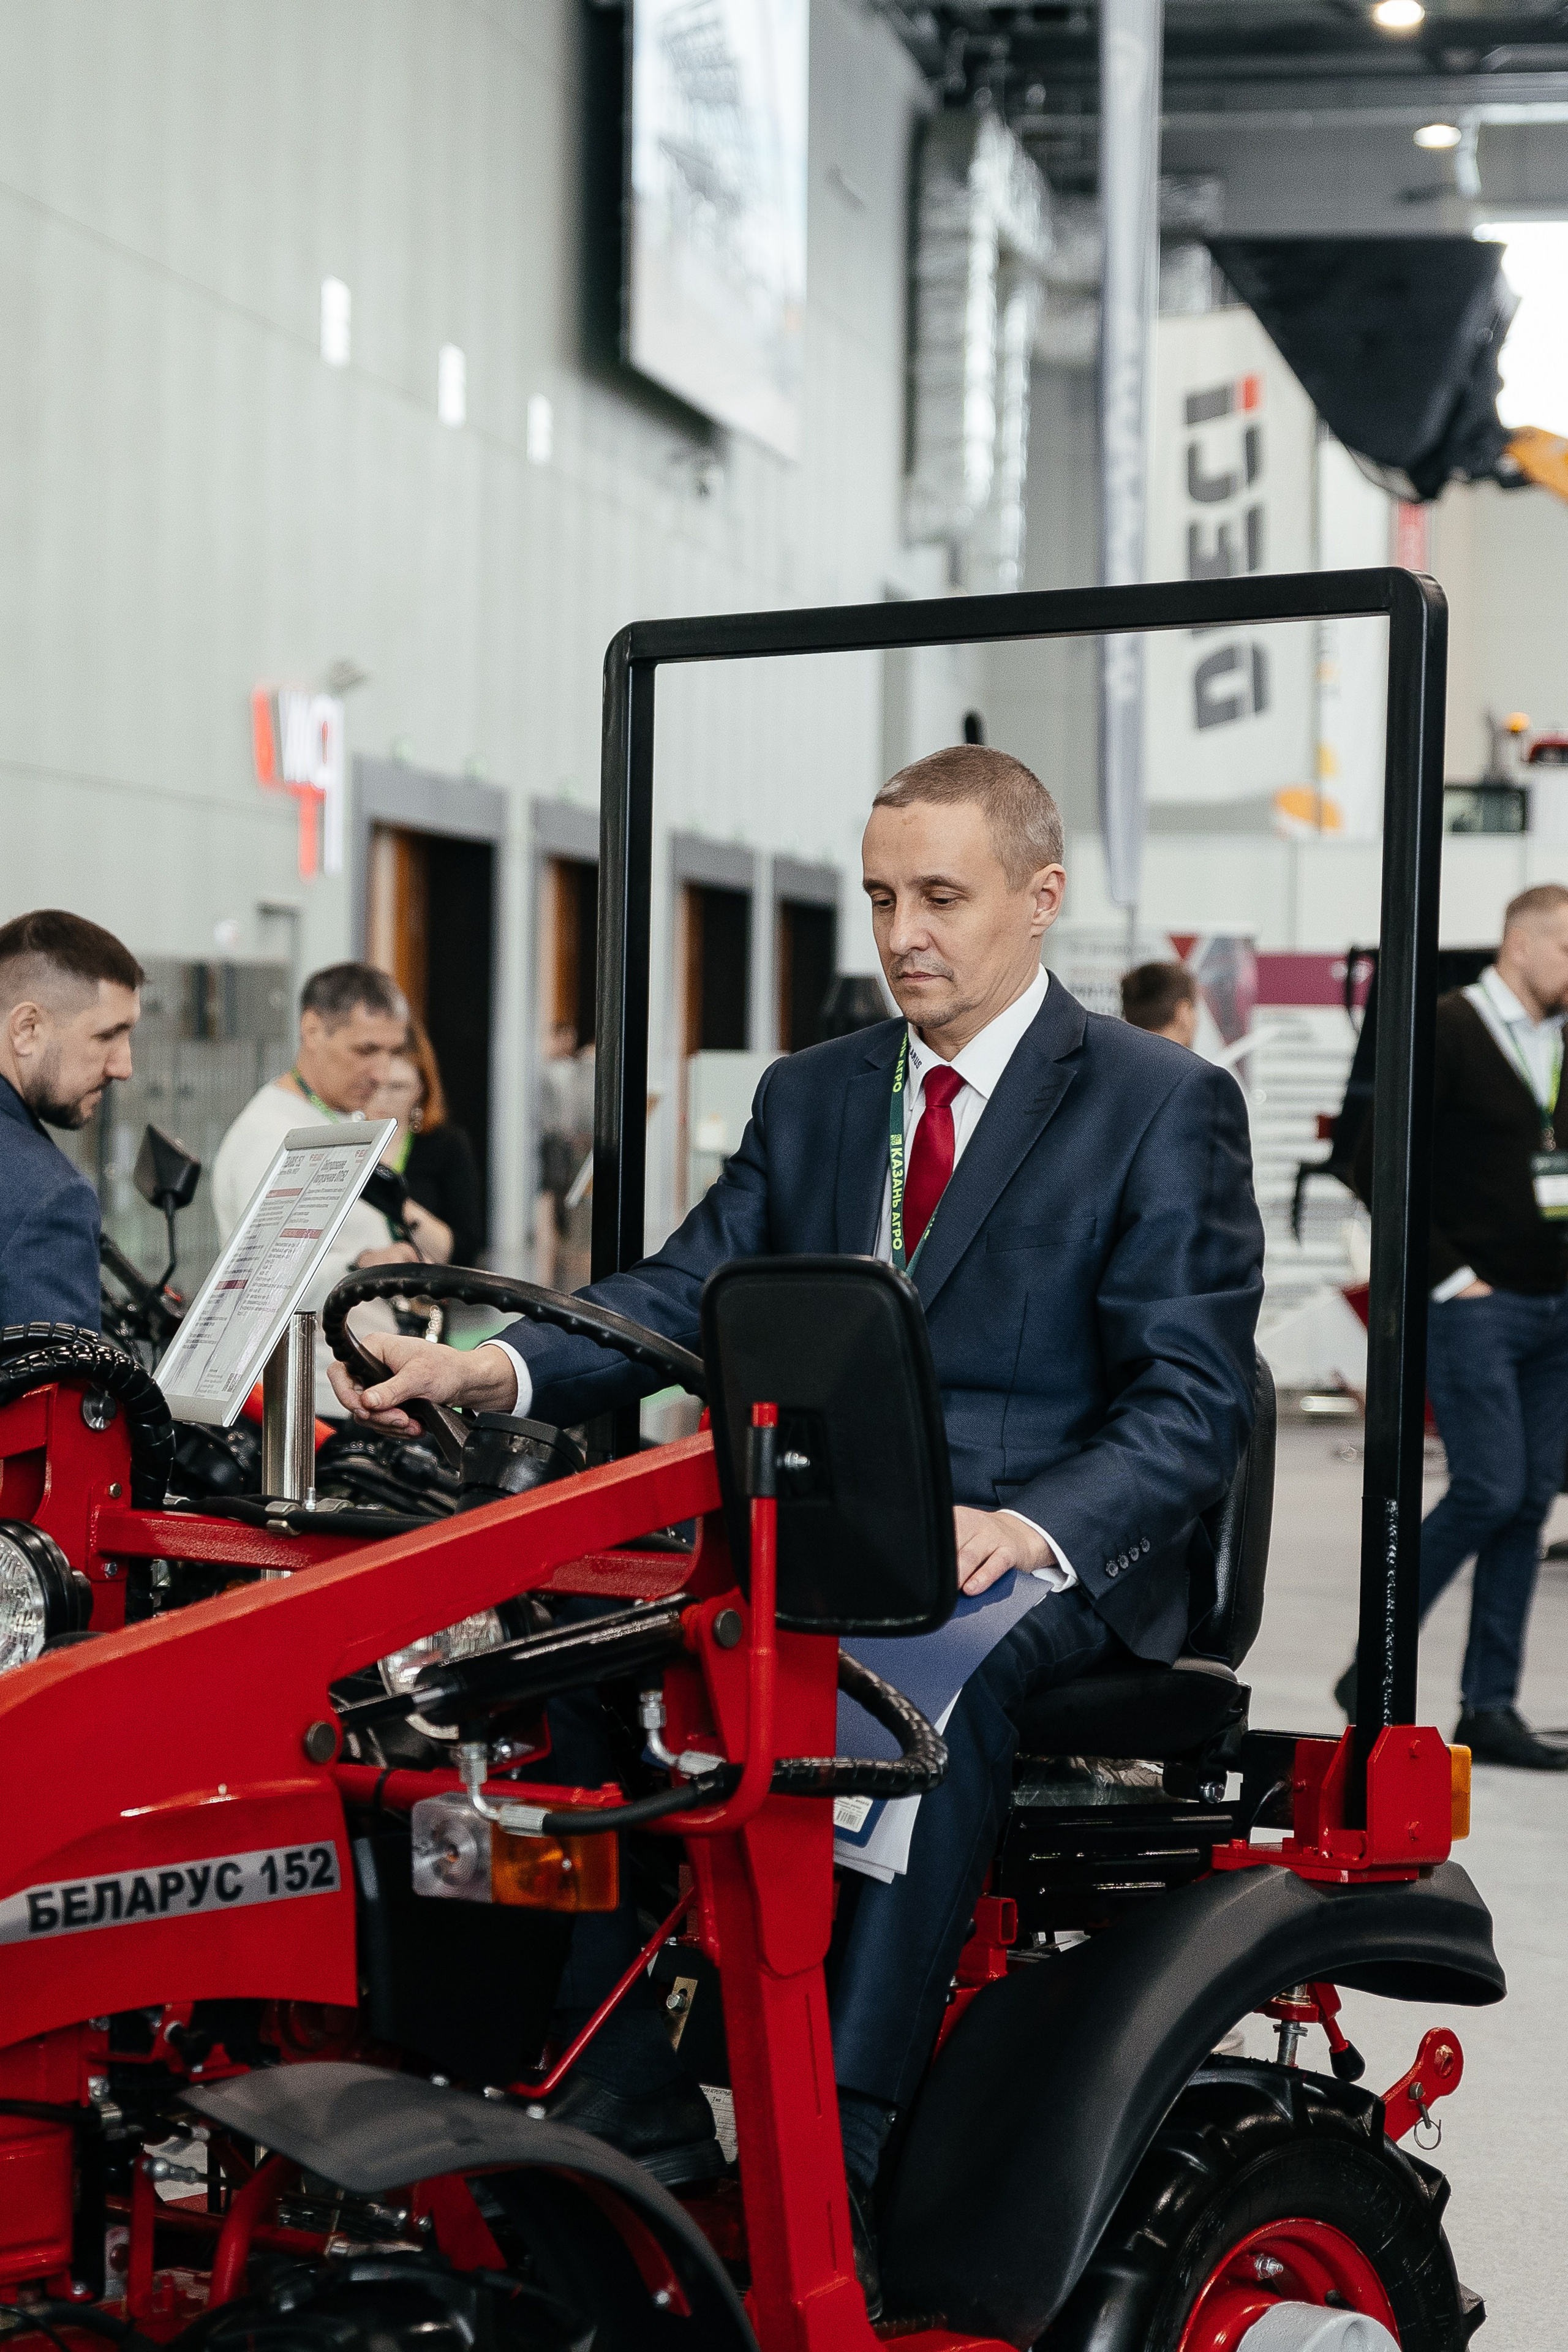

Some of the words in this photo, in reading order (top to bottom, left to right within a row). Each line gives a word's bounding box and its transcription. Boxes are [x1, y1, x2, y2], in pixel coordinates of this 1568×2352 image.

[892, 1060, 905, 1093] АГРО
[891, 1147, 903, 1208] КАЗАНЬ
[892, 1212, 903, 1251] АГРО
[28, 1861, 244, 1933] БЕЛАРУС
[260, 1847, 335, 1896] 152
